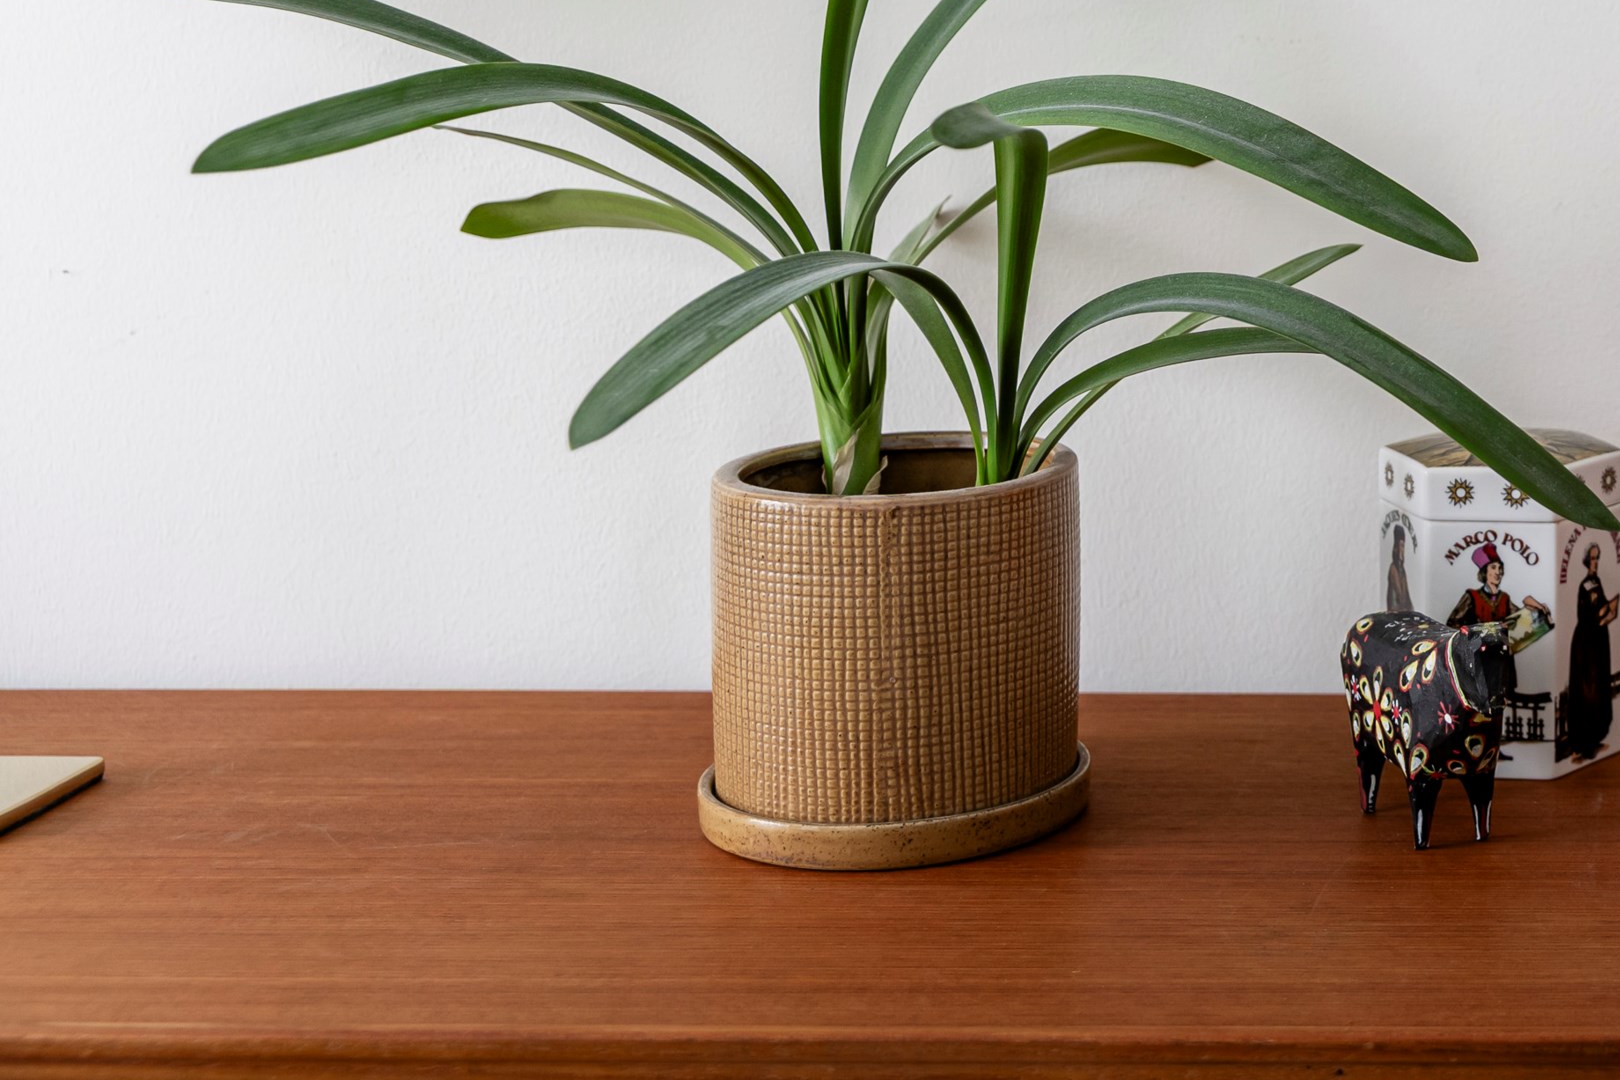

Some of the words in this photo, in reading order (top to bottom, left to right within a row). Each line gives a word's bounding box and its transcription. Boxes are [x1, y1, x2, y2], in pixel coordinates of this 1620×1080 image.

[1444, 529, 1498, 566] MARCO
[1502, 532, 1540, 567] POLO
[1559, 527, 1582, 585] HELENA
